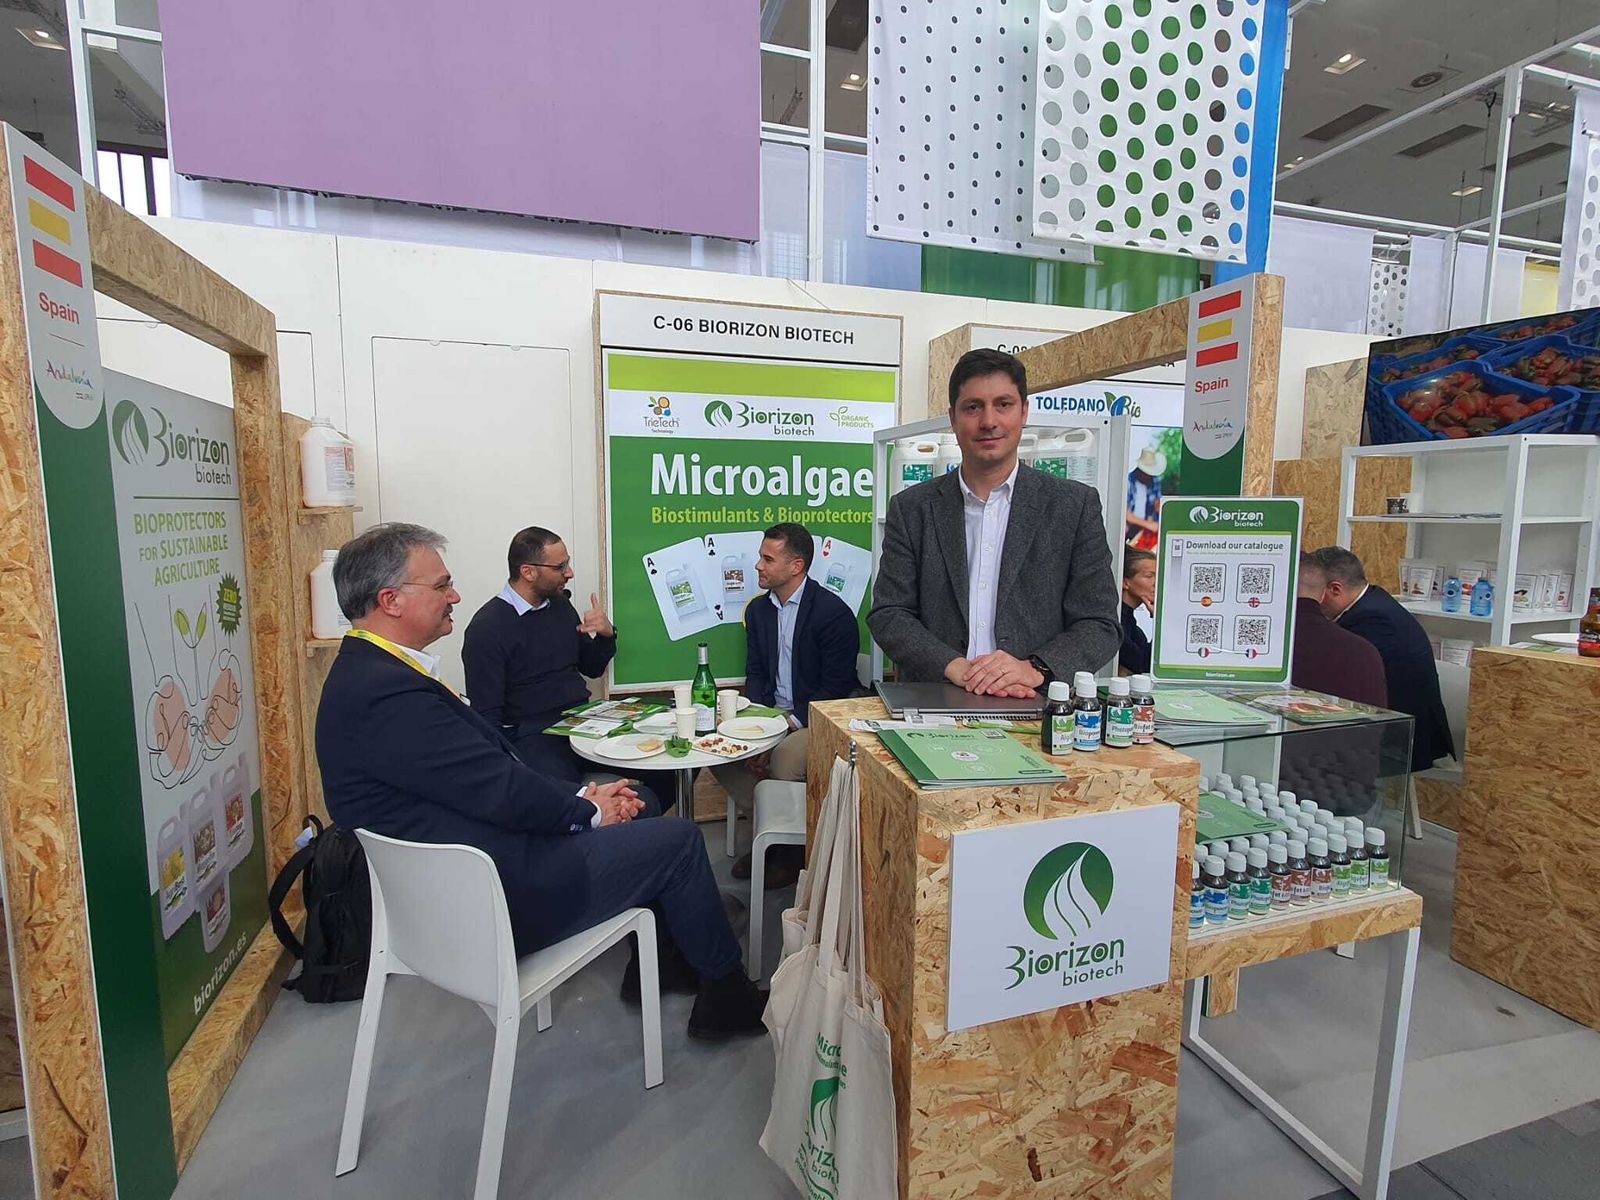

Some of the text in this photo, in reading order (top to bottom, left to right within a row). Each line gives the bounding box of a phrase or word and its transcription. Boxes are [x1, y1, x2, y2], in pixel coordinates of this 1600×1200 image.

[39, 292, 80, 325] Spain
[653, 315, 854, 345] C-06 BIORIZON BIOTECH
[1195, 377, 1229, 394] Spain
[736, 401, 814, 428] Biorizon
[1035, 396, 1106, 412] TOLEDANO
[149, 406, 230, 468] Biorizon
[774, 425, 815, 436] biotech
[196, 463, 232, 485] biotech
[651, 453, 874, 507] Microalgae
[133, 511, 227, 534] BIOPROTECTORS
[651, 507, 874, 527] Biostimulants & Bioprotectors
[1209, 506, 1264, 523] Biorizon
[139, 536, 229, 562] FOR SUSTAINABLE
[1186, 541, 1226, 550] Download
[1243, 541, 1284, 552] catalogue
[154, 558, 220, 587] AGRICULTURE
[193, 934, 247, 1014] biorizon.es
[1004, 938, 1124, 989] Biorizon
[1062, 960, 1124, 987] biotech
